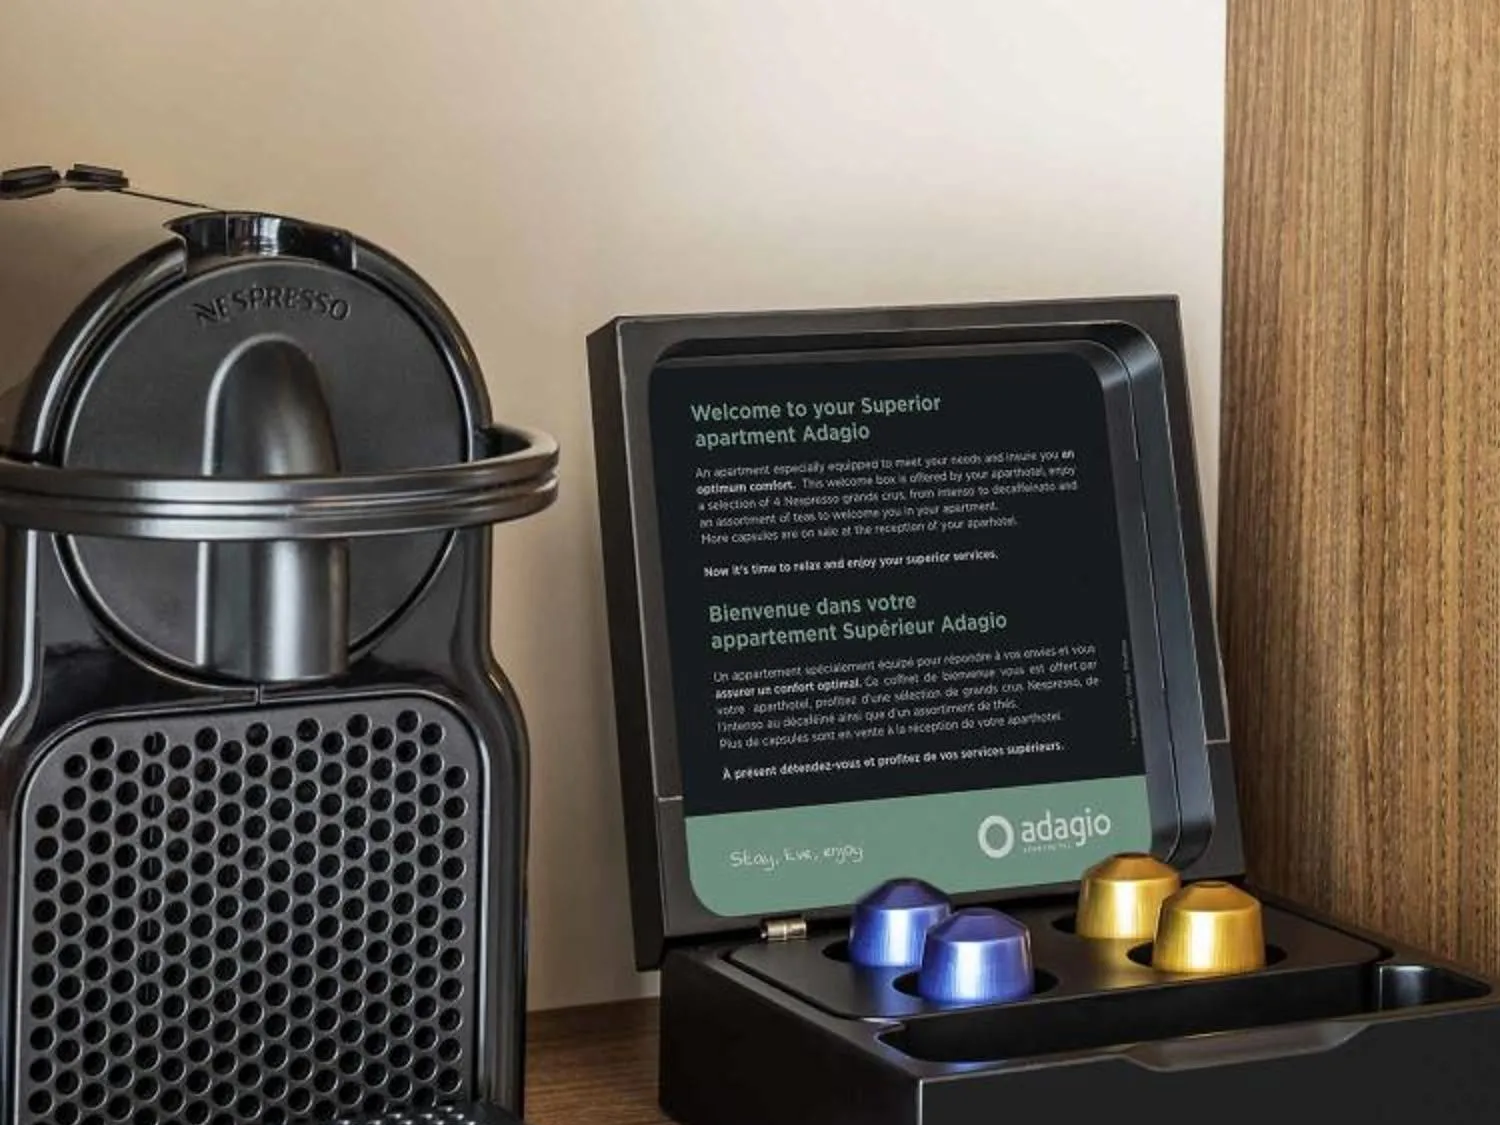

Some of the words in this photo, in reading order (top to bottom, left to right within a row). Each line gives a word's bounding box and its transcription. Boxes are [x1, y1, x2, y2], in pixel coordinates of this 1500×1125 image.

[191, 284, 351, 323] NESPRESSO
[690, 402, 781, 422] Welcome
[786, 401, 807, 417] to
[813, 401, 855, 420] your
[861, 394, 941, 416] Superior
[695, 426, 796, 451] apartment
[803, 422, 870, 443] Adagio
[731, 564, 750, 576] it's
[751, 563, 777, 575] time
[793, 560, 822, 572] relax
[846, 556, 877, 569] enjoy
[878, 556, 904, 569] your
[905, 551, 951, 565] superior
[952, 549, 999, 561] services.
[709, 603, 811, 623] Bienvenue
[816, 597, 862, 616] dans
[867, 594, 917, 612] votre
[711, 624, 837, 652] appartement
[843, 617, 935, 641] Supérieur
[941, 611, 1007, 633] Adagio
[733, 765, 777, 781] présent
[779, 759, 862, 775] détendez-vous
[877, 753, 921, 769] profitez
[960, 745, 1005, 759] services
[1020, 807, 1112, 847] adagio
[729, 849, 779, 872] Stay,
[823, 844, 864, 865] enjoy
